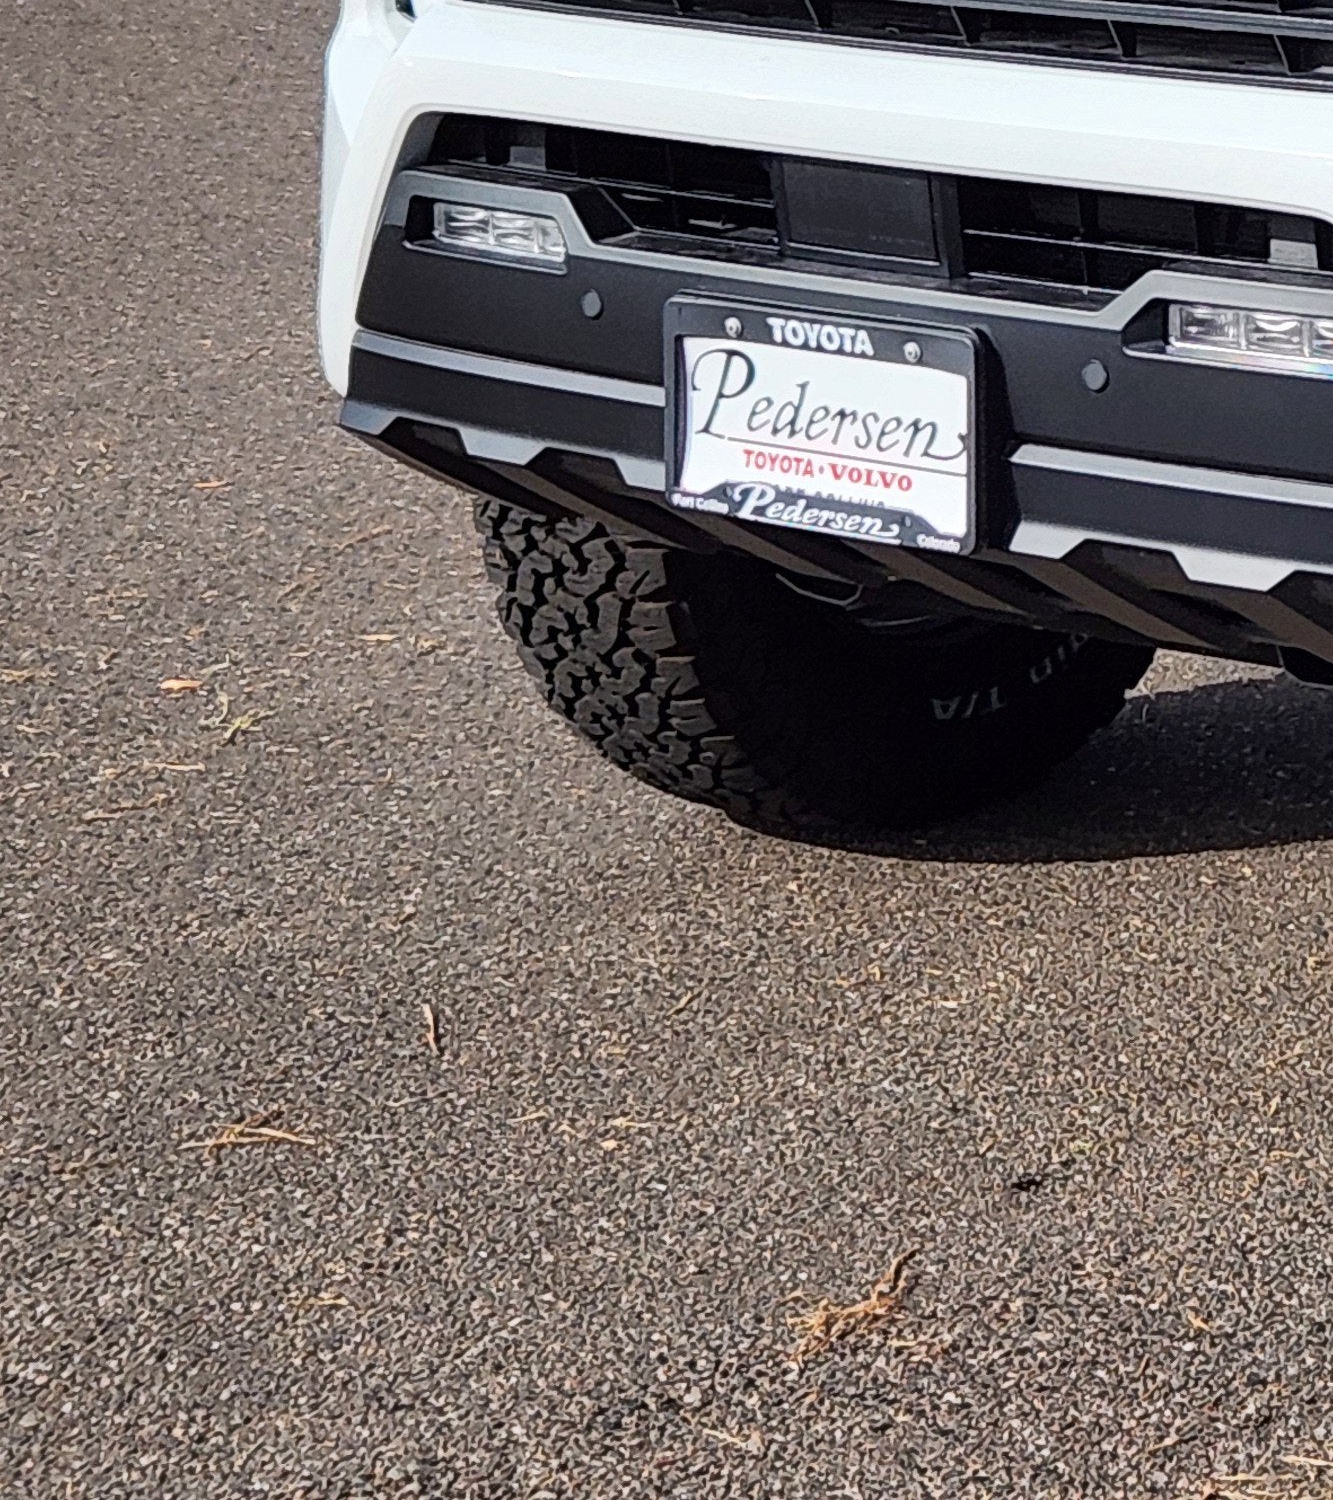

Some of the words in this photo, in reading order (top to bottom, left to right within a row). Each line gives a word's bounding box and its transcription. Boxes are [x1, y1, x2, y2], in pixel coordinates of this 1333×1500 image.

[766, 316, 874, 357] TOYOTA
[691, 348, 970, 461] Pedersen
[743, 449, 815, 478] TOYOTA
[827, 462, 913, 492] VOLVO
[733, 481, 900, 538] Pedersen
